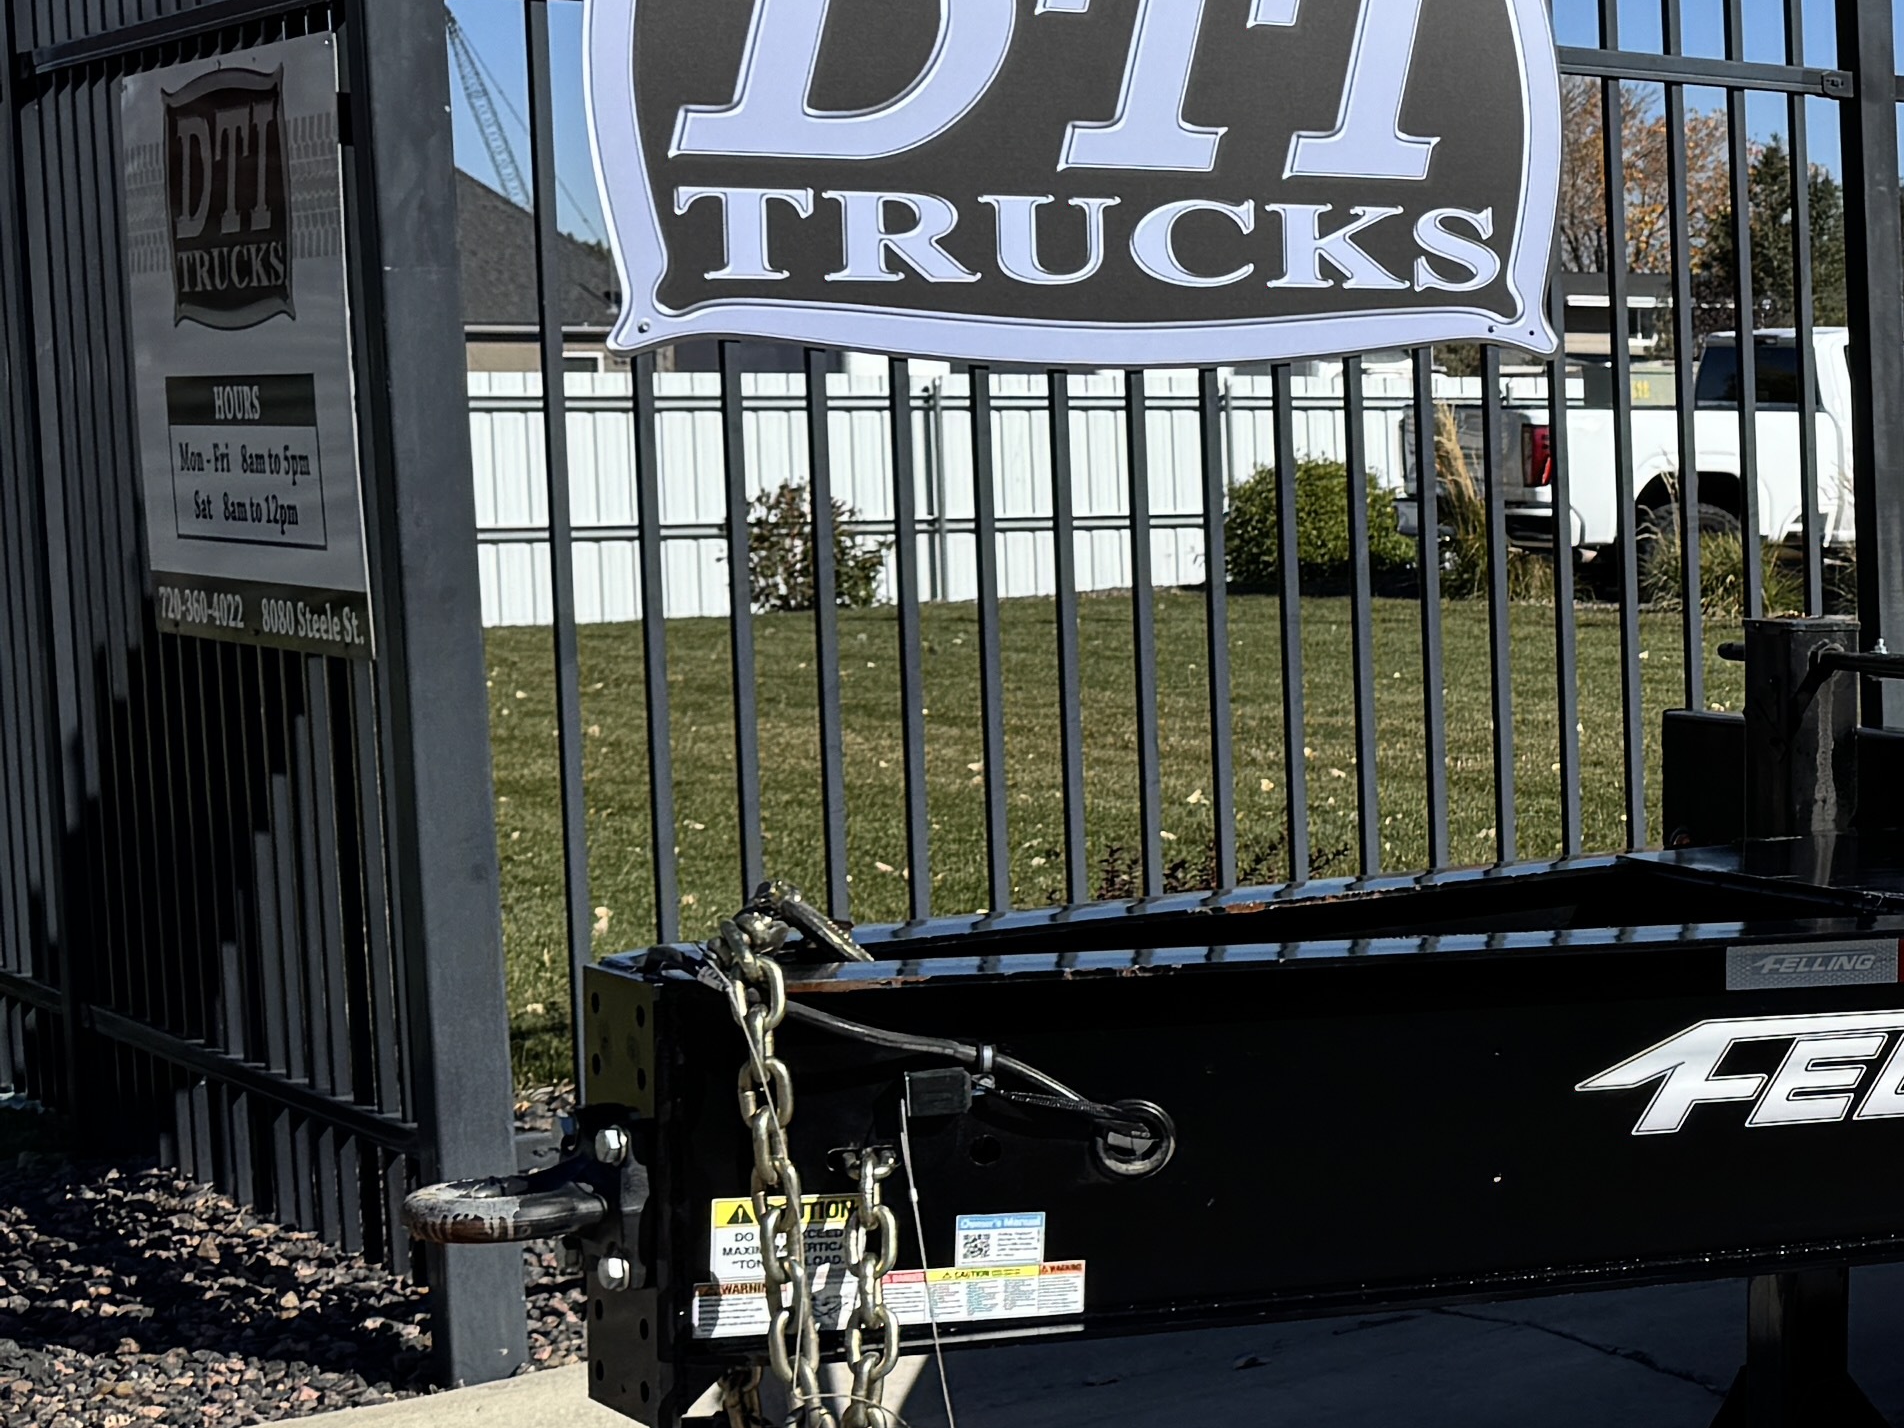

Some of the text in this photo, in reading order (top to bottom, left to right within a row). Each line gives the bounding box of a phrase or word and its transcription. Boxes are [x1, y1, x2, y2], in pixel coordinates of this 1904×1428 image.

[176, 102, 275, 239] DTI
[673, 186, 1508, 293] TRUCKS
[178, 241, 286, 293] TRUCKS
[213, 385, 261, 420] HOURS
[179, 442, 205, 472] Mon
[212, 442, 231, 473] Fri
[240, 444, 266, 473] 8am
[268, 448, 281, 475] to
[283, 445, 311, 486] 5pm
[194, 490, 299, 535] Sat 8am to 12pm
[158, 586, 365, 645] 720-360-4022 8080 Steele St.
[1751, 950, 1876, 974] FELLING
